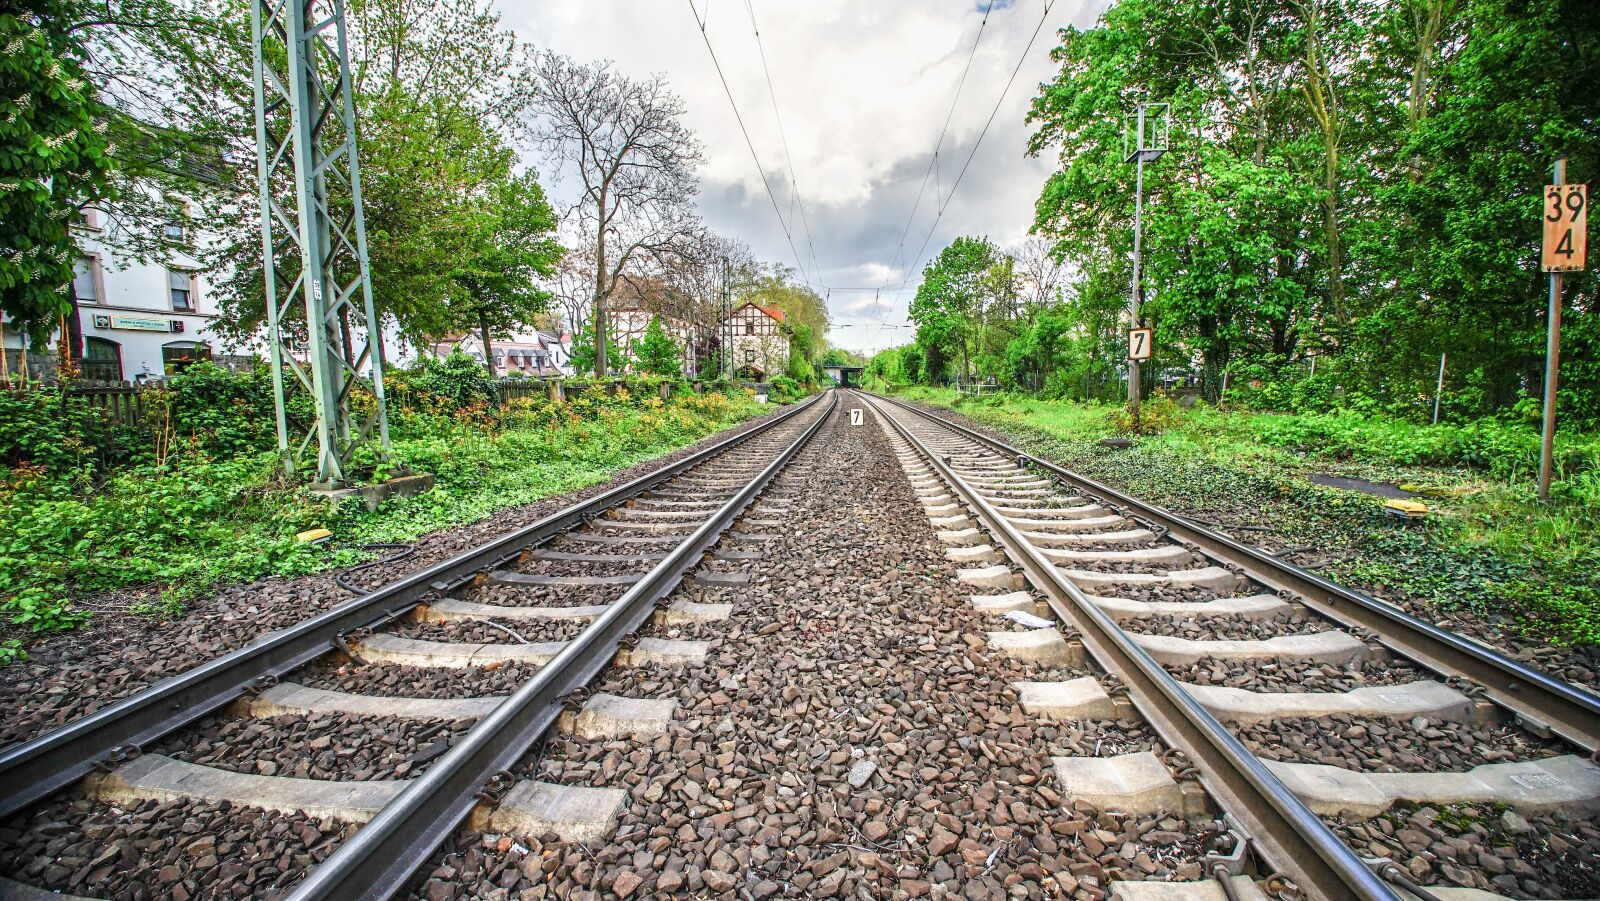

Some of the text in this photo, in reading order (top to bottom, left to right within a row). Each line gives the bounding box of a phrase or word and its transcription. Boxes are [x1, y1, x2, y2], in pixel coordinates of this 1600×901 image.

[1546, 191, 1584, 223] 39
[1554, 228, 1575, 260] 4
[1134, 333, 1145, 355] 7
[853, 411, 860, 424] 7
